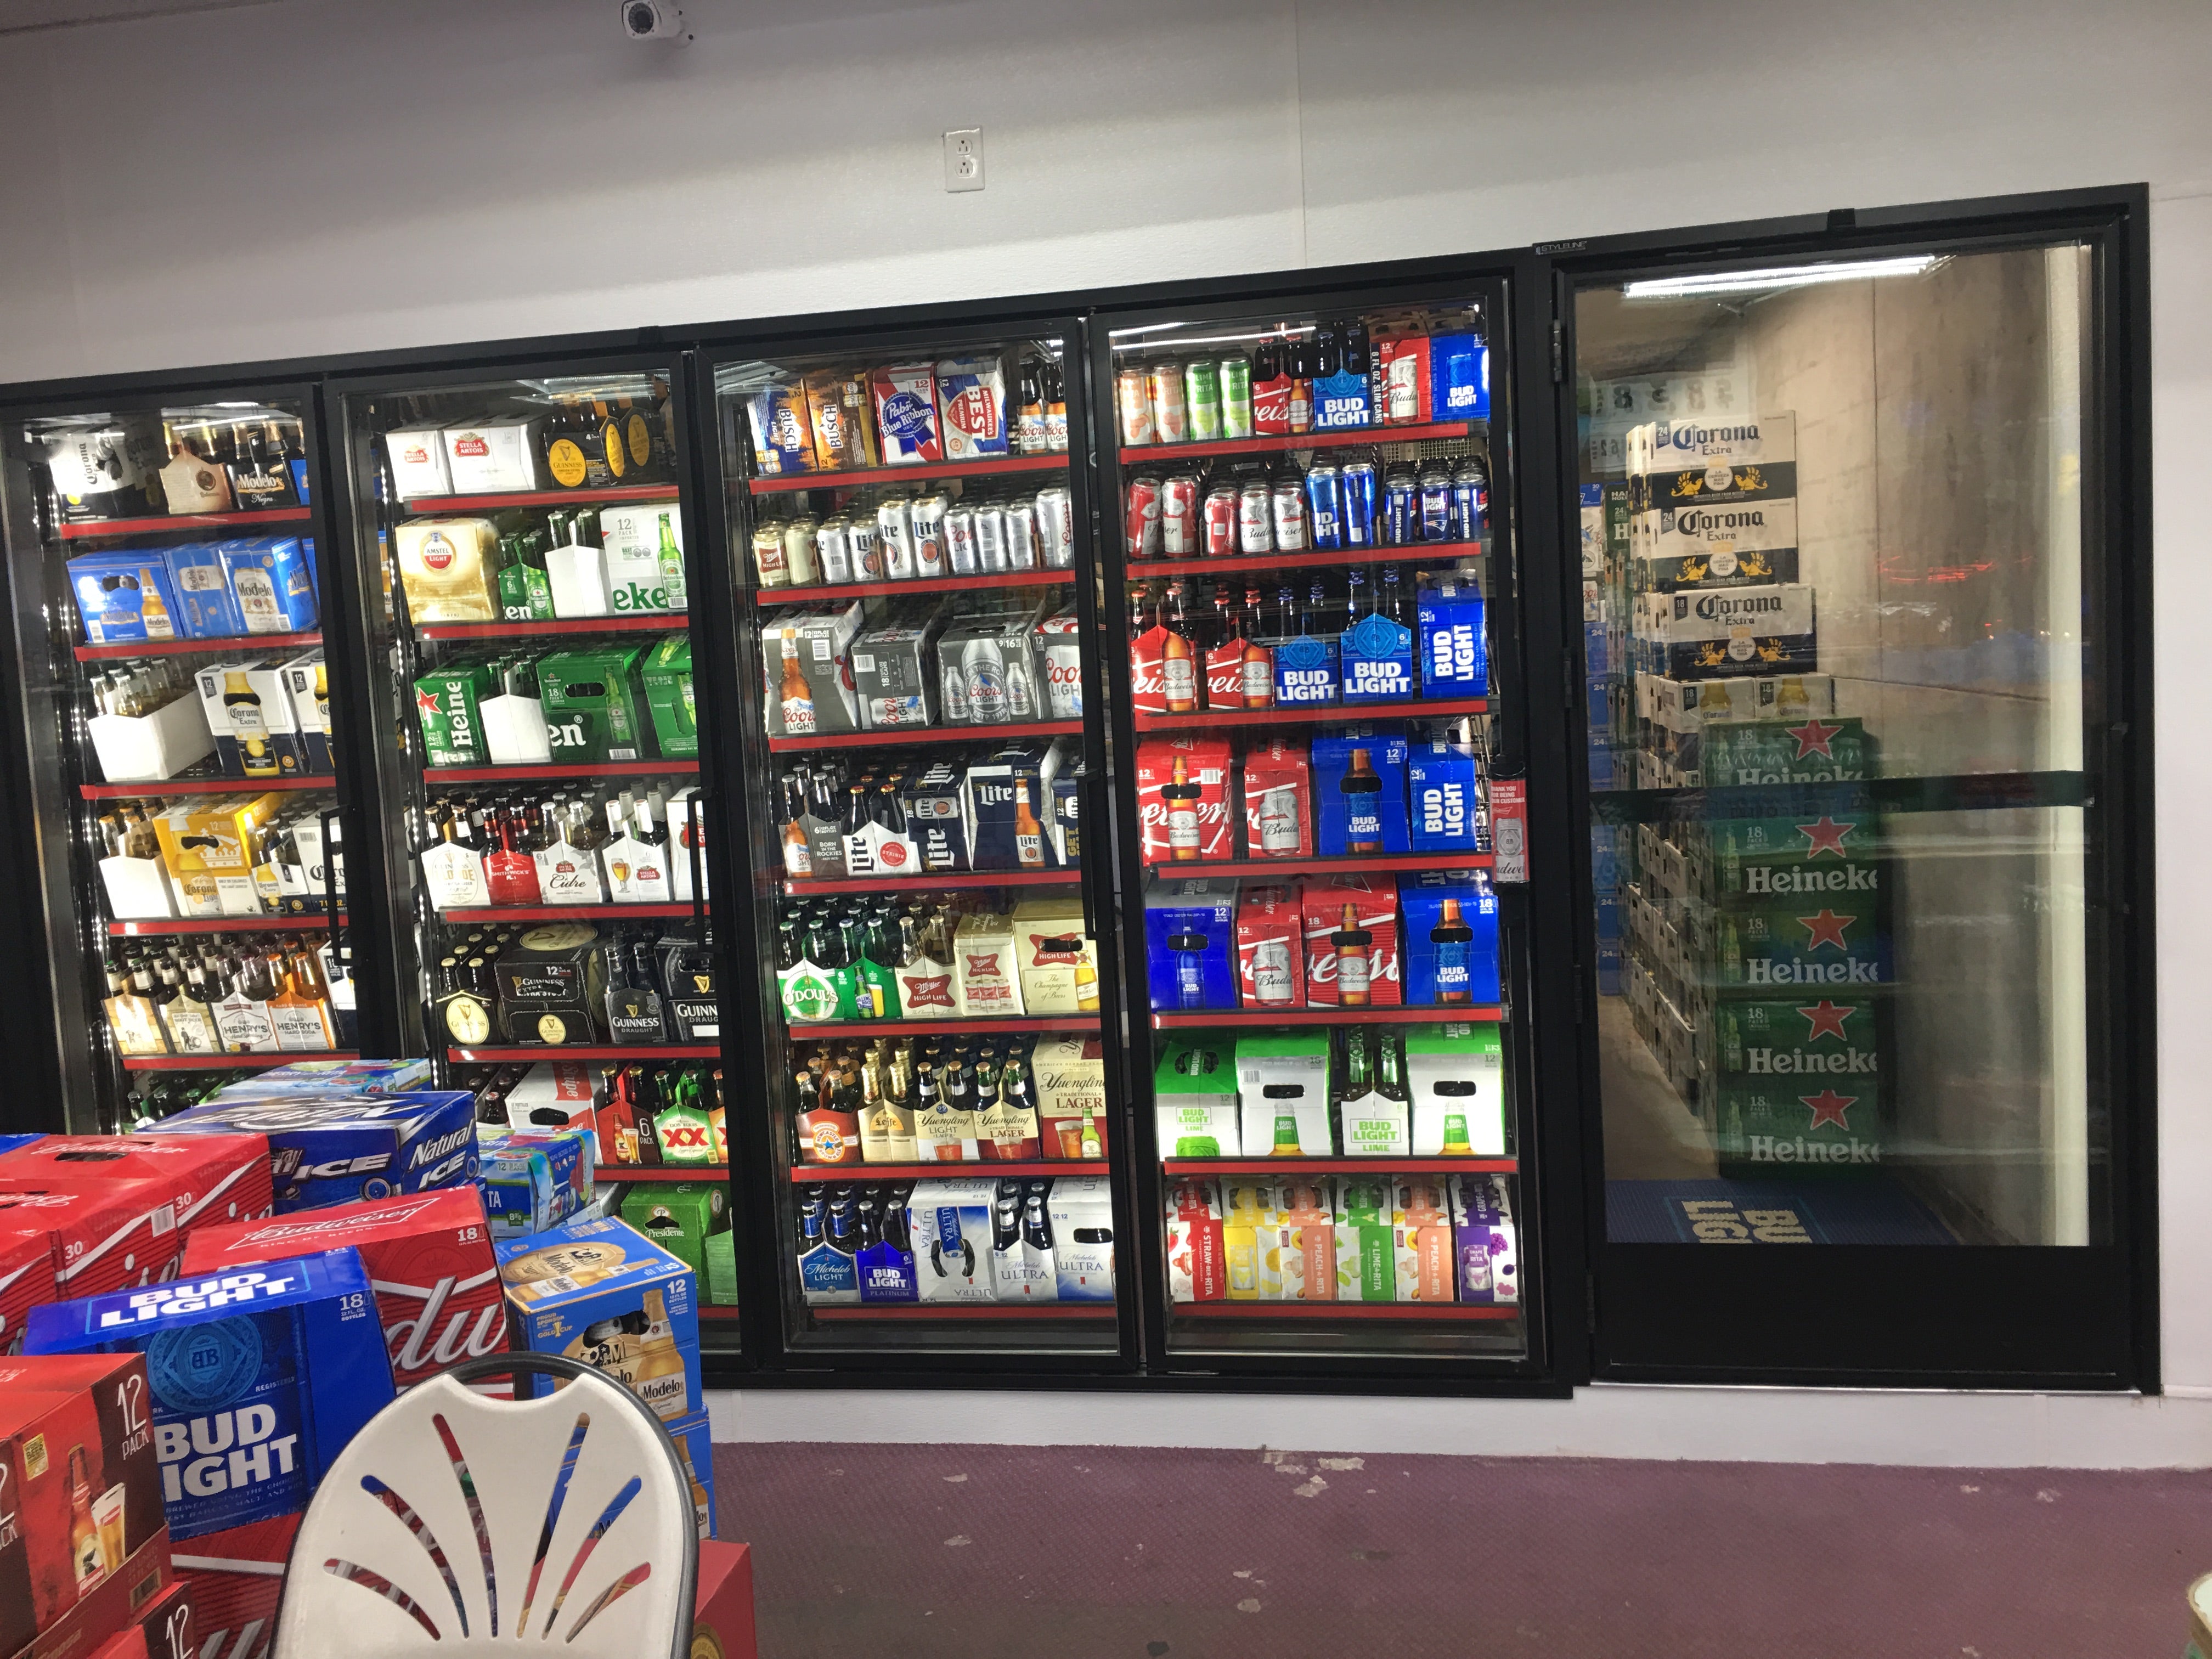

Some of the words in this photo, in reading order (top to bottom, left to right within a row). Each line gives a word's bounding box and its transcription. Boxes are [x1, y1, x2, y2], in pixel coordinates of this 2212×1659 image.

[1541, 241, 1586, 252] STYLELINE
[914, 380, 929, 388] 12
[1196, 384, 1214, 392] RITA
[1372, 385, 1382, 402] SLIM
[1449, 386, 1474, 397] BUD
[1324, 398, 1364, 413] BUD
[1447, 394, 1477, 407] LIGHT
[885, 400, 913, 419] Pabst
[957, 399, 966, 430] PREMIUM
[965, 385, 986, 442] BEST
[880, 421, 901, 437] Blue
[900, 408, 933, 429] Ribbon
[1318, 410, 1370, 426] LIGHT
[778, 408, 798, 453] BUSCH
[830, 404, 842, 449] BUSCH
[1658, 427, 1668, 437] 24
[1673, 424, 1760, 452] Corona
[1702, 445, 1733, 456] Extra
[251, 494, 273, 505] Negra
[617, 518, 631, 530] 12
[1677, 510, 1765, 537] Corona
[1707, 531, 1736, 541] Extra
[237, 582, 272, 597] Modelo
[1696, 594, 1783, 622] Corona
[1725, 616, 1755, 627] Extra
[1433, 631, 1453, 678] BUD
[1453, 624, 1475, 681] LIGHT
[1354, 662, 1401, 678] BUD
[203, 679, 213, 688] 12
[294, 674, 303, 683] 12
[1284, 670, 1329, 686] BUD
[549, 688, 559, 696] 18
[970, 684, 1002, 696] Coors
[1277, 684, 1336, 701] LIGHT
[1345, 677, 1410, 695] LIGHT
[447, 681, 473, 748] Heine
[789, 723, 815, 732] LIGHT
[980, 784, 1013, 806] Lite
[1424, 788, 1443, 833] BUD
[1444, 783, 1463, 837] LIGHT
[1348, 823, 1380, 833] LIGHT
[1351, 817, 1376, 825] BUD
[1746, 826, 1763, 838] 18
[928, 826, 956, 867] Lite
[1019, 835, 1039, 848] Lite
[1067, 827, 1076, 856] GET
[816, 849, 842, 857] ROCKIES
[851, 836, 874, 873] Lite
[550, 873, 586, 889] Cidre
[1479, 899, 1492, 908] 18
[973, 957, 992, 966] Miller
[546, 966, 558, 975] 12
[1439, 966, 1466, 975] BUD
[1436, 972, 1470, 984] LIGHT
[914, 980, 941, 994] Miller
[1034, 981, 1068, 991] Champagne
[783, 986, 839, 1004] O'DOUL'S
[1041, 992, 1048, 1001] of
[1049, 991, 1066, 1000] Beers
[677, 1005, 716, 1017] GUINN
[223, 1024, 268, 1034] HENRY'S
[276, 1022, 321, 1030] HENRY'S
[613, 1017, 659, 1028] GUINNESS
[561, 1063, 579, 1098] Stripe
[1056, 1098, 1103, 1108] LAGER
[1177, 1114, 1210, 1124] LIGHT
[1182, 1108, 1205, 1117] BUD
[639, 1118, 650, 1136] 6
[874, 1116, 897, 1127] Leffe
[917, 1113, 972, 1128] Yuengling
[977, 1113, 1031, 1128] Yuengling
[1358, 1120, 1392, 1132] BUD
[1446, 1122, 1465, 1131] LIGHT
[661, 1126, 711, 1148] XX
[929, 1126, 957, 1135] LIGHT
[989, 1130, 1025, 1138] LAGER
[1353, 1130, 1398, 1142] LIGHT
[407, 1118, 475, 1173] Natural
[292, 1152, 392, 1180] ICE
[418, 1150, 466, 1192] ICE
[175, 1192, 192, 1209] 30
[488, 1191, 501, 1207] TA
[244, 1206, 420, 1242] Budweiser
[458, 1228, 478, 1242] 18
[645, 1228, 685, 1238] Presidente
[64, 1241, 83, 1260] 30
[804, 1263, 851, 1276] Michelob
[1059, 1261, 1104, 1271] ULTRA
[1203, 1234, 1214, 1296] STRAW-BER-RITA
[1316, 1244, 1325, 1296] PEACH-A-RITA
[1430, 1242, 1440, 1296] PEACH-A-RITA
[814, 1273, 843, 1282] LIGHT
[872, 1268, 901, 1279] BUD
[1001, 1269, 1049, 1281] ULTRA
[129, 1272, 268, 1308] BUD
[667, 1279, 686, 1294] 12
[868, 1278, 907, 1289] LIGHT
[100, 1276, 295, 1328] LIGHT
[339, 1294, 364, 1311] 18
[385, 1276, 508, 1370] du
[537, 1313, 556, 1321] PROUD
[537, 1315, 565, 1326] SPONSOR
[538, 1329, 556, 1339] GOLD
[642, 1380, 680, 1400] Modelo
[117, 1374, 146, 1436] 12
[154, 1404, 275, 1463] BUD
[122, 1427, 149, 1461] PACK
